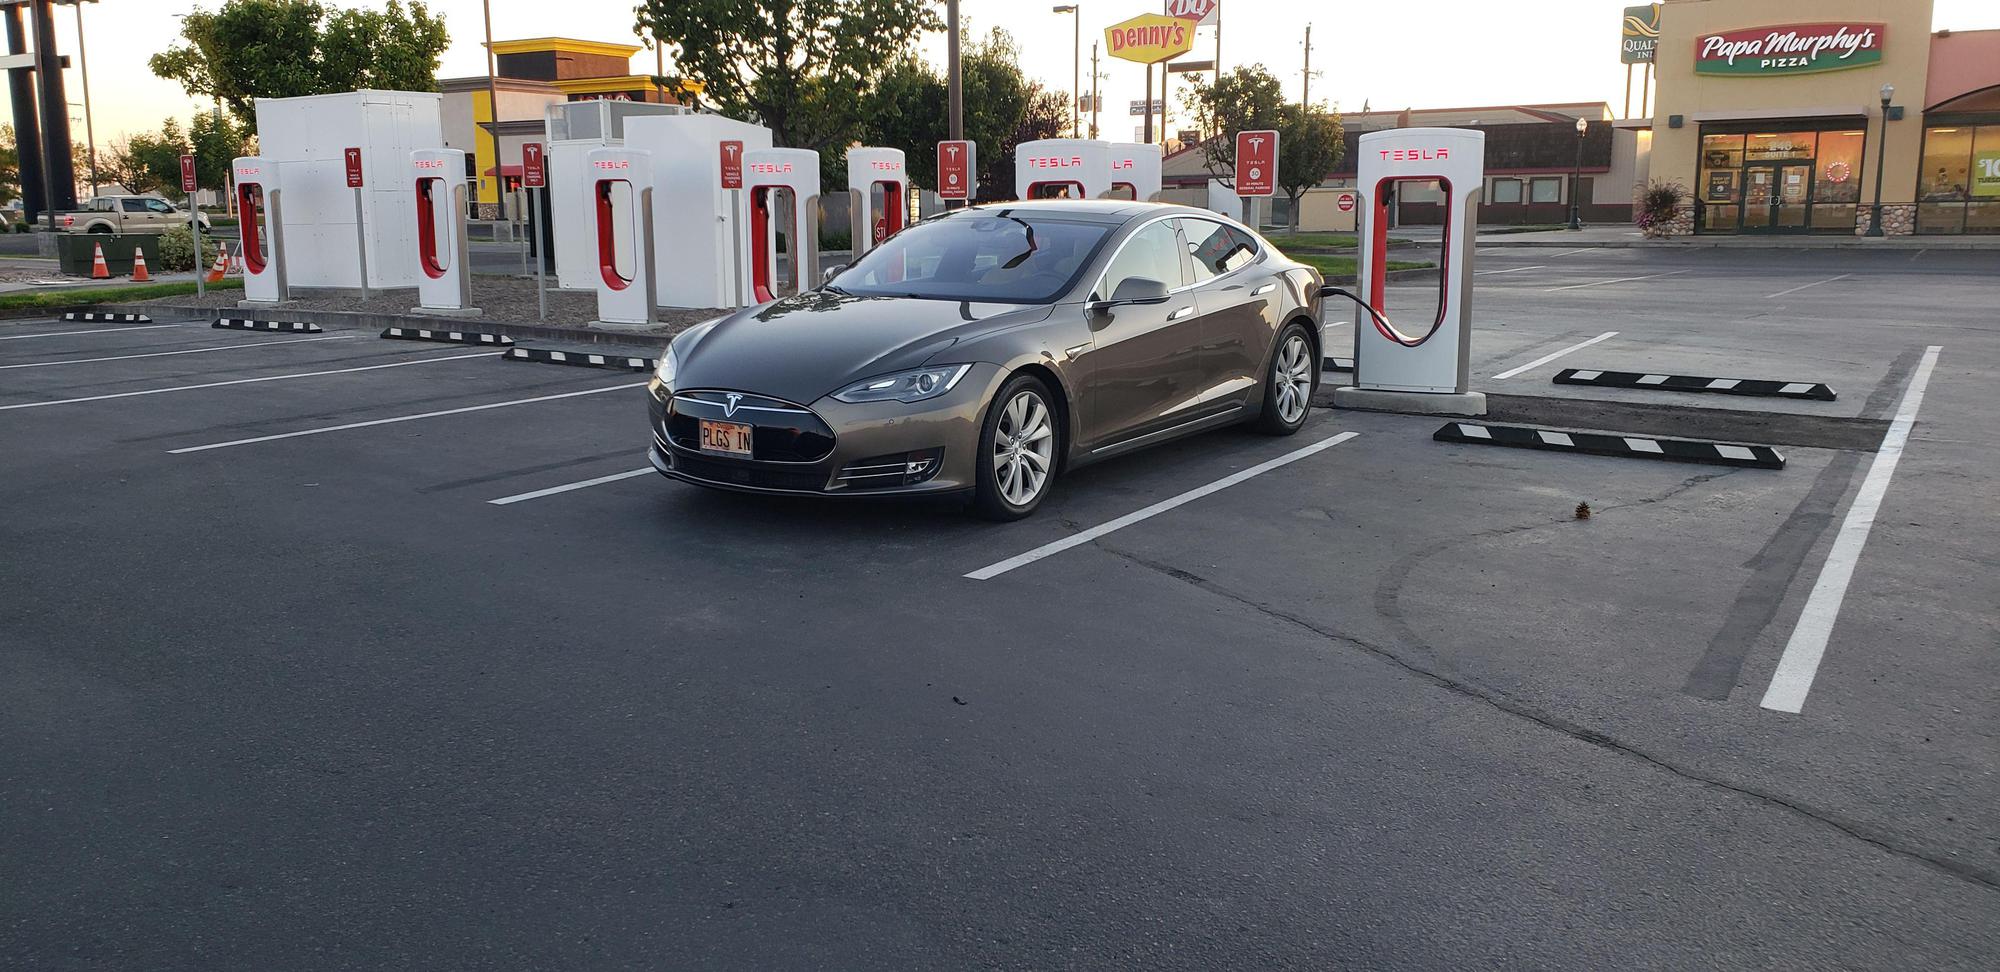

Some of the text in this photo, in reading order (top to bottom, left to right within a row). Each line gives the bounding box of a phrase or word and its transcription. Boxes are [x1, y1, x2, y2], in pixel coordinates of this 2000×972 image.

[1111, 21, 1185, 51] Denny's
[1623, 39, 1659, 53] QUAL
[1702, 27, 1876, 66] Papa Murphy's
[1761, 58, 1808, 68] PIZZA
[1380, 149, 1448, 160] TESLA
[594, 161, 629, 169] TESLA
[871, 162, 901, 170] TESLA
[1029, 157, 1081, 168] TESLA
[751, 164, 792, 173] TESLA
[876, 226, 886, 238] ST
[703, 427, 751, 451] PLGS IN
